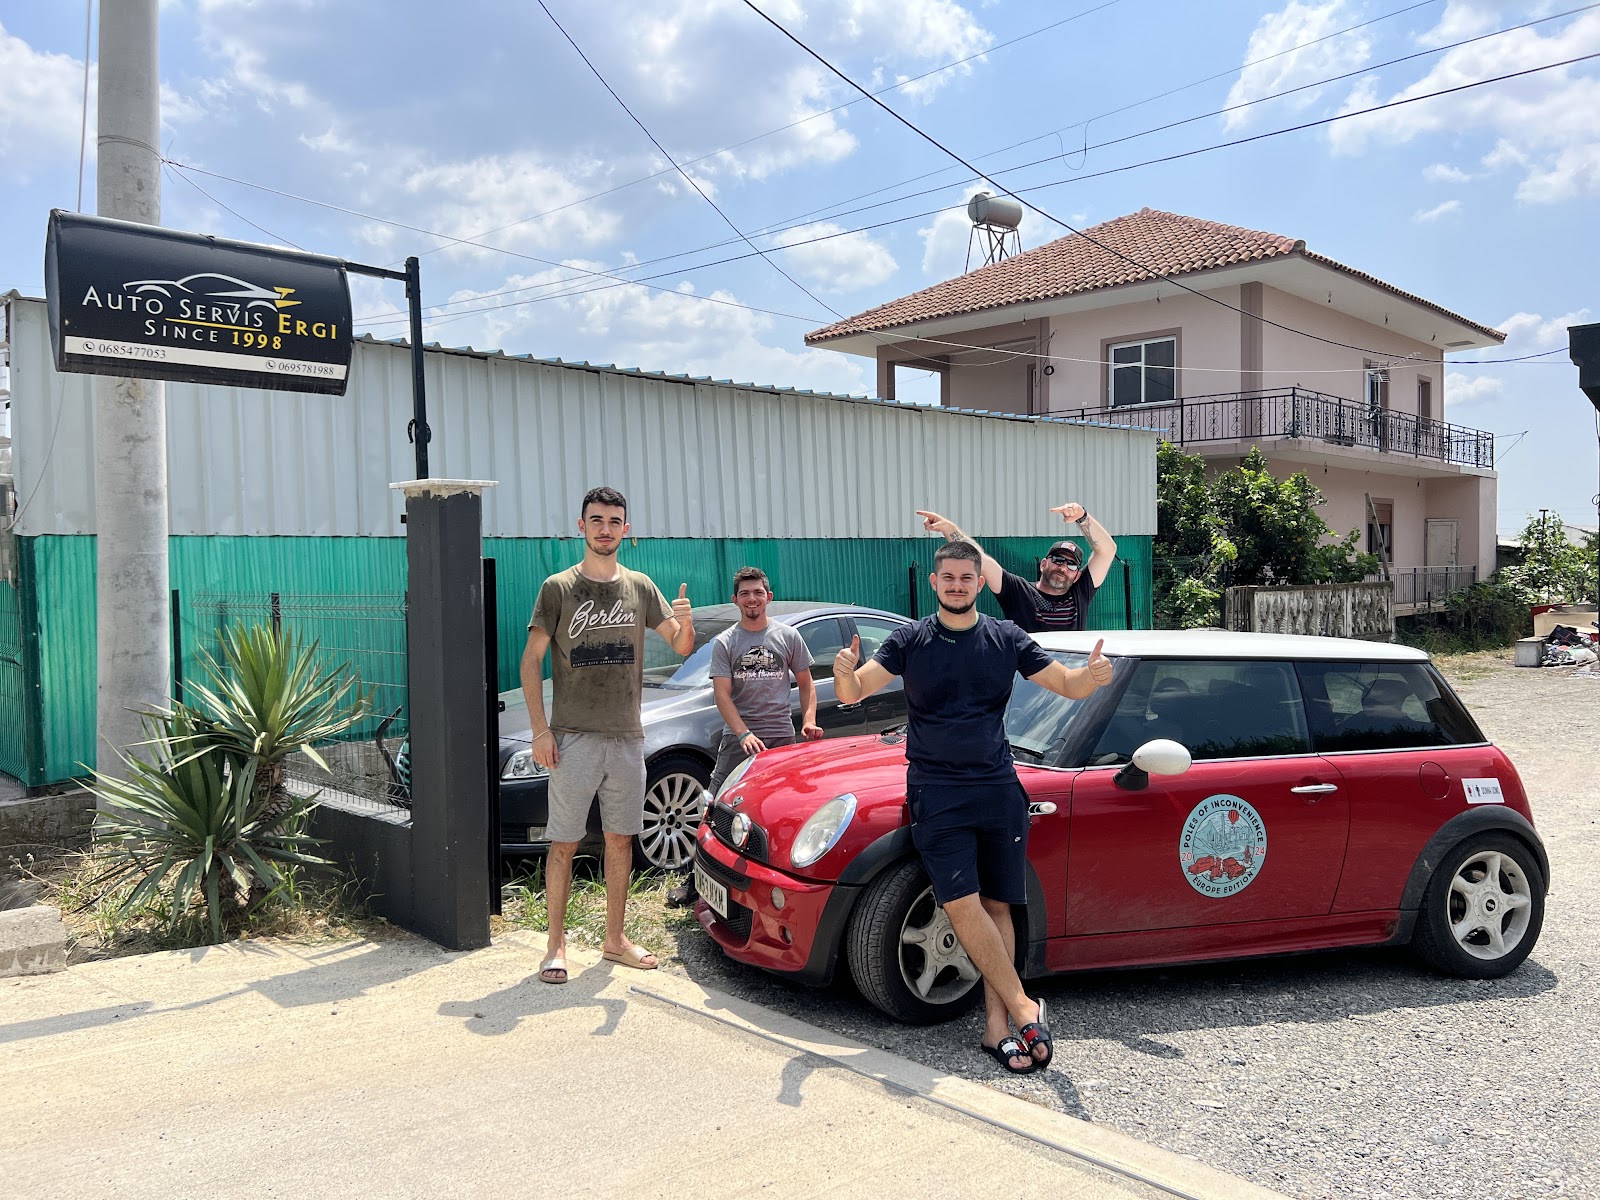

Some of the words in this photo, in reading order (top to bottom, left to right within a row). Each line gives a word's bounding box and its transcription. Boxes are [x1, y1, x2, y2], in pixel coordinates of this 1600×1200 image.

[82, 285, 164, 315] AUTO
[179, 299, 263, 328] SERVIS
[278, 313, 337, 340] ERGI
[144, 319, 218, 343] SINCE
[232, 331, 282, 350] 1998
[98, 343, 166, 359] 0685477053
[278, 362, 334, 376] 0695781988
[568, 599, 636, 639] Berlin
[1183, 817, 1199, 848] POLES
[1198, 804, 1209, 817] OF
[1211, 799, 1264, 843] INCONVENIENCE
[1181, 851, 1193, 862] 20
[1255, 846, 1265, 856] 24
[1192, 876, 1221, 894] EUROPE
[1223, 871, 1254, 894] EDITION
